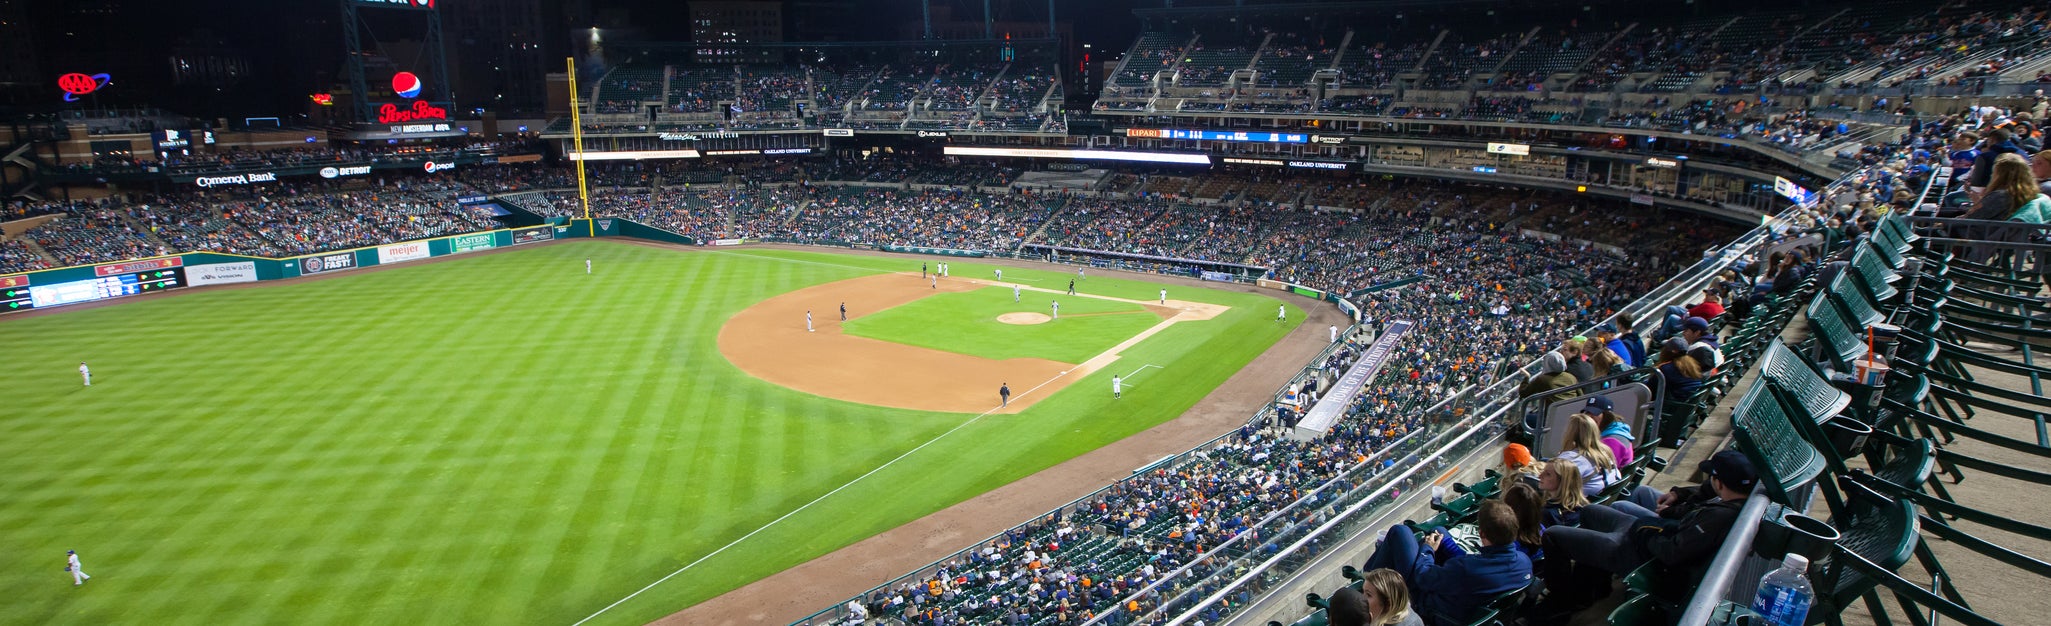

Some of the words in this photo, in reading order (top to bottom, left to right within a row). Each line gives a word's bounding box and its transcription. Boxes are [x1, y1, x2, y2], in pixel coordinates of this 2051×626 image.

[61, 75, 95, 92] AAA
[403, 124, 434, 132] AMSTERDAM
[1131, 129, 1157, 137] LIPARI
[340, 165, 371, 175] DETROIT
[248, 172, 276, 182] Bank
[456, 234, 490, 244] EASTERN
[389, 244, 419, 256] meijer
[324, 253, 351, 262] FREAKY
[214, 264, 253, 272] FORWARD
[324, 259, 351, 270] FAST!
[1329, 384, 1354, 403] HOME
[1361, 346, 1386, 366] DETROIT
